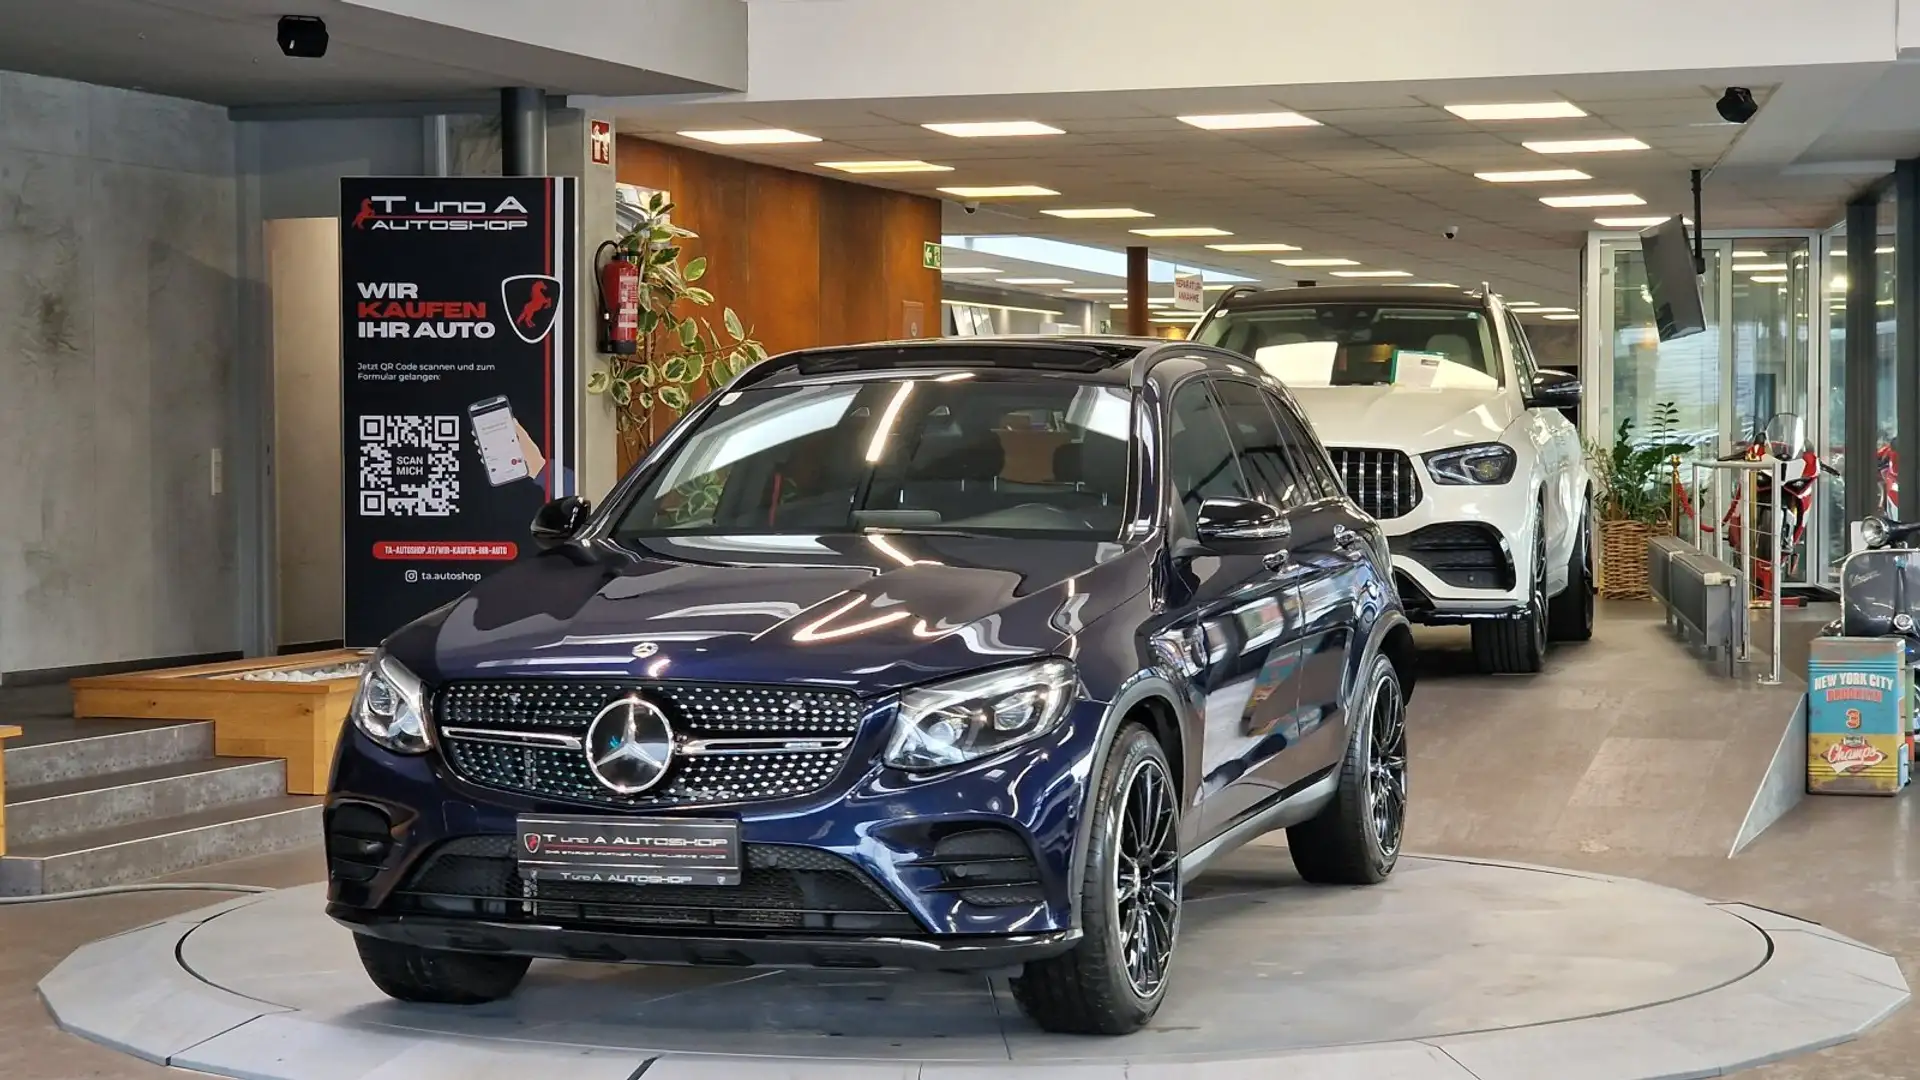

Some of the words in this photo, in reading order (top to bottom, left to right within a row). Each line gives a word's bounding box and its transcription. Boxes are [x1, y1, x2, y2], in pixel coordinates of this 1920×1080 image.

[371, 196, 406, 213] T
[493, 196, 528, 213] A
[371, 220, 528, 230] AUTOSHOP
[357, 282, 418, 299] WIR
[357, 302, 486, 318] KAUFEN
[358, 321, 412, 339] IHR
[413, 321, 496, 339] AUTO
[357, 363, 379, 371] Jetzt
[380, 363, 394, 371] QR
[395, 363, 418, 371] Code
[457, 363, 475, 371] und
[398, 373, 441, 382] gelangen:
[396, 456, 423, 465] SCAN
[396, 466, 423, 475] MICH
[421, 572, 482, 582] ta.autoshop
[1814, 674, 1837, 690] NEW
[1839, 672, 1867, 685] YORK
[1869, 674, 1894, 691] CITY
[1846, 708, 1861, 729] 3
[542, 834, 557, 842] T
[593, 836, 607, 844] A
[612, 836, 728, 846] AUTOSHOP
[560, 872, 572, 880] T
[592, 873, 602, 881] A
[608, 874, 692, 883] AUTOSHOP
